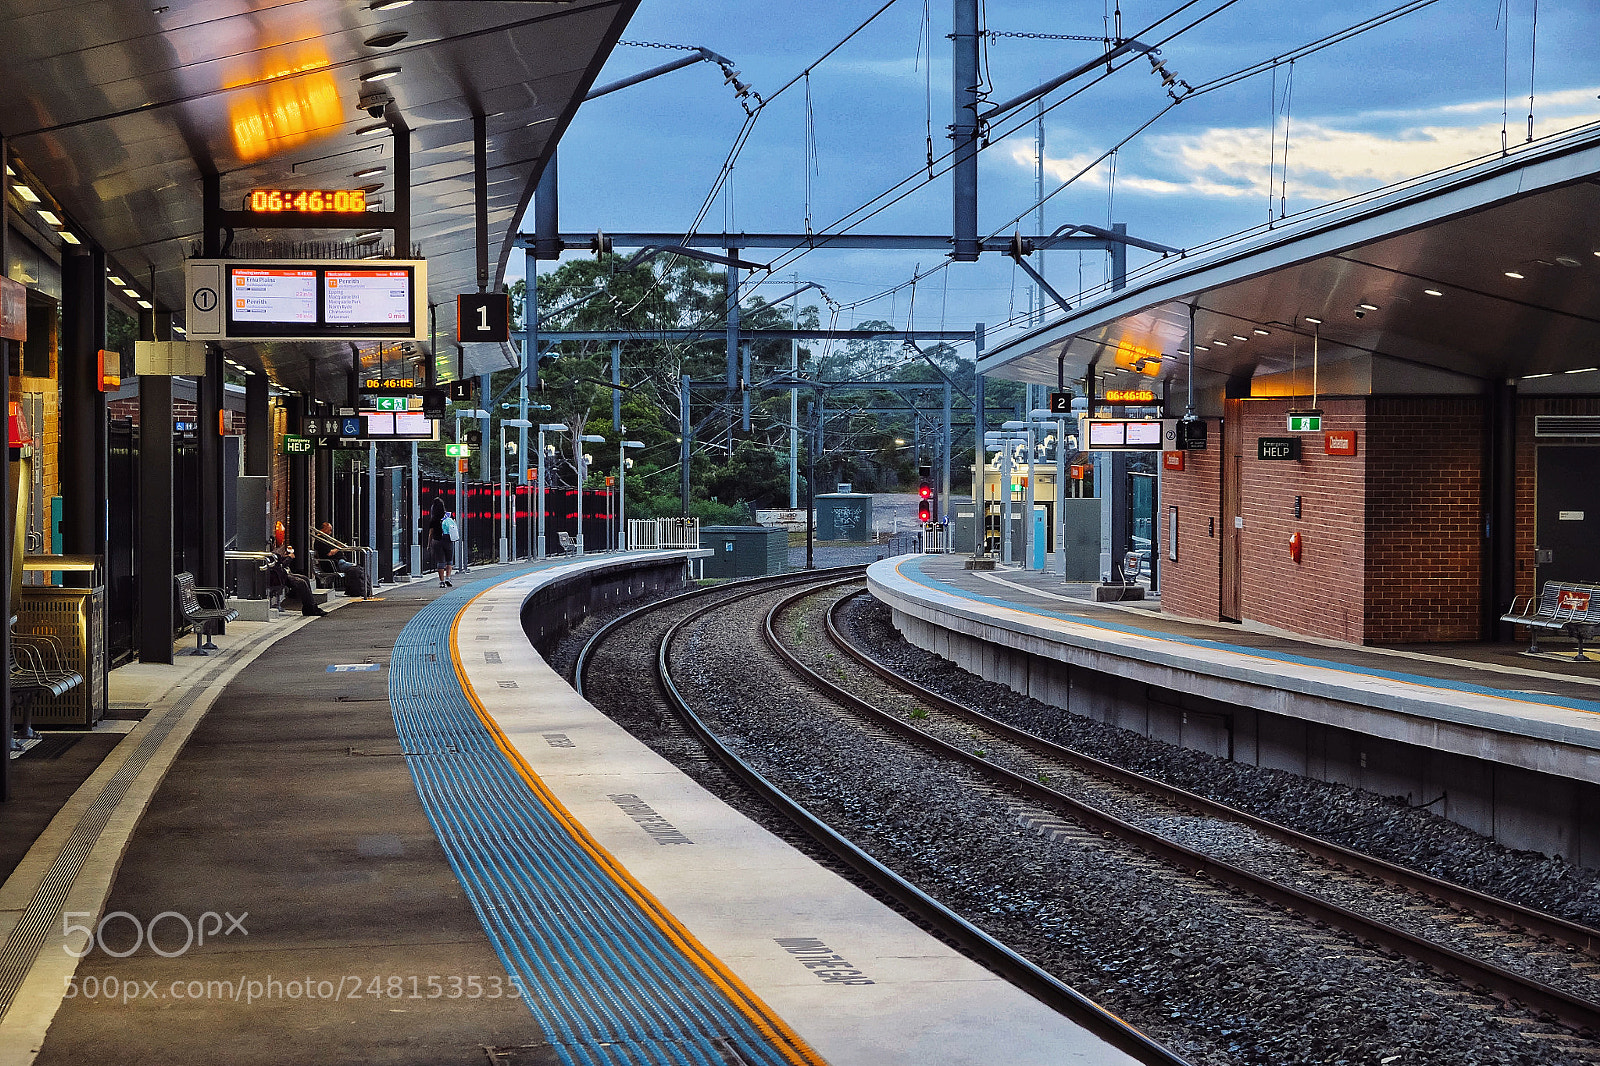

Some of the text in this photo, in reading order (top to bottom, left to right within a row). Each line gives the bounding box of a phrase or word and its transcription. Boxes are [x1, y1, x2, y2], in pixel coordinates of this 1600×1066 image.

[476, 305, 491, 331] 1
[366, 379, 414, 388] 06:46:05
[457, 385, 465, 396] 1
[1057, 397, 1066, 409] 2
[287, 442, 311, 452] HELP
[1263, 447, 1290, 457] HELP
